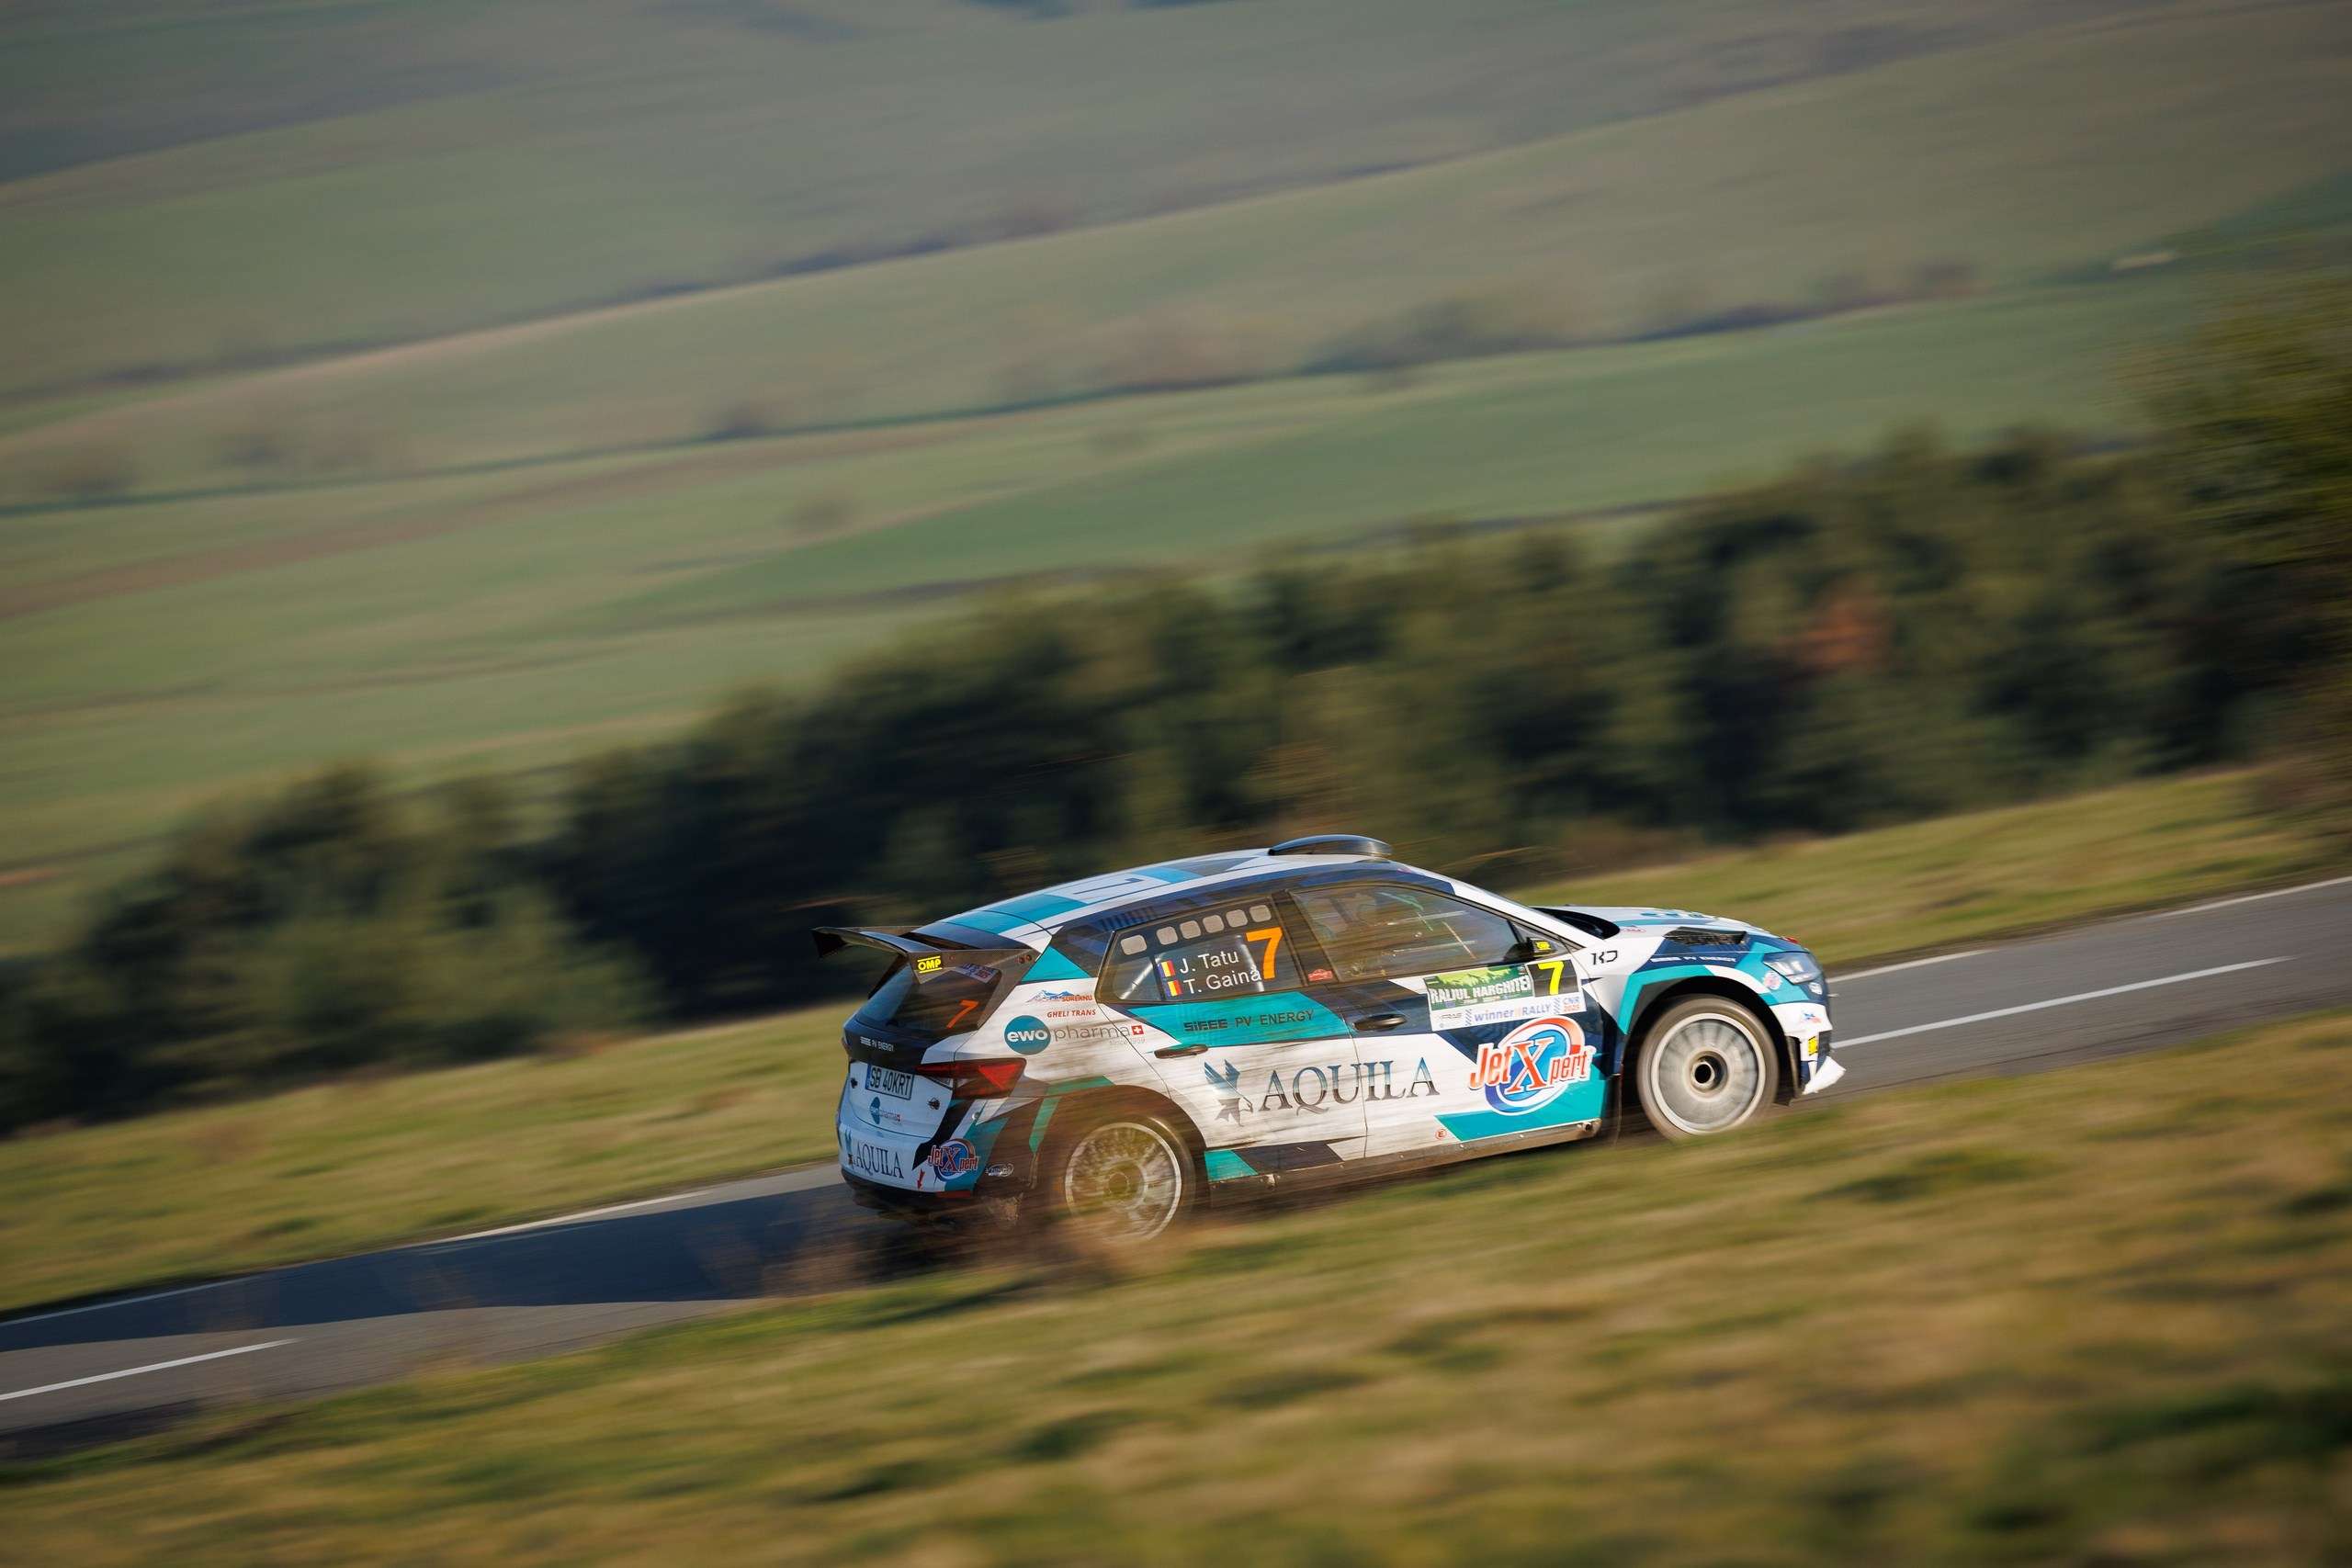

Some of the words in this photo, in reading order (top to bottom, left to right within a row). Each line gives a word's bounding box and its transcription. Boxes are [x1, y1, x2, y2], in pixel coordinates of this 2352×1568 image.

[1180, 958, 1196, 975] J.
[1198, 950, 1239, 969] Tatu
[1246, 927, 1283, 980] 7
[918, 958, 942, 971] OMP
[1183, 978, 1202, 994] T.
[1537, 961, 1564, 995] 7
[1430, 987, 1471, 1004] RALIUL
[946, 999, 979, 1028] 7
[1046, 1010, 1069, 1019] GHELI
[1235, 1016, 1252, 1028] PV
[1260, 1010, 1315, 1025] ENERGY
[1475, 1010, 1514, 1022] winner
[1521, 1004, 1552, 1016] RALLY
[1007, 1030, 1048, 1043] ewo
[1054, 1025, 1131, 1043] pharma
[870, 1067, 883, 1089] SB
[883, 1071, 911, 1096] 40KRT
[1259, 1057, 1441, 1116] AQUILA
[854, 1142, 904, 1179] AQUILA
